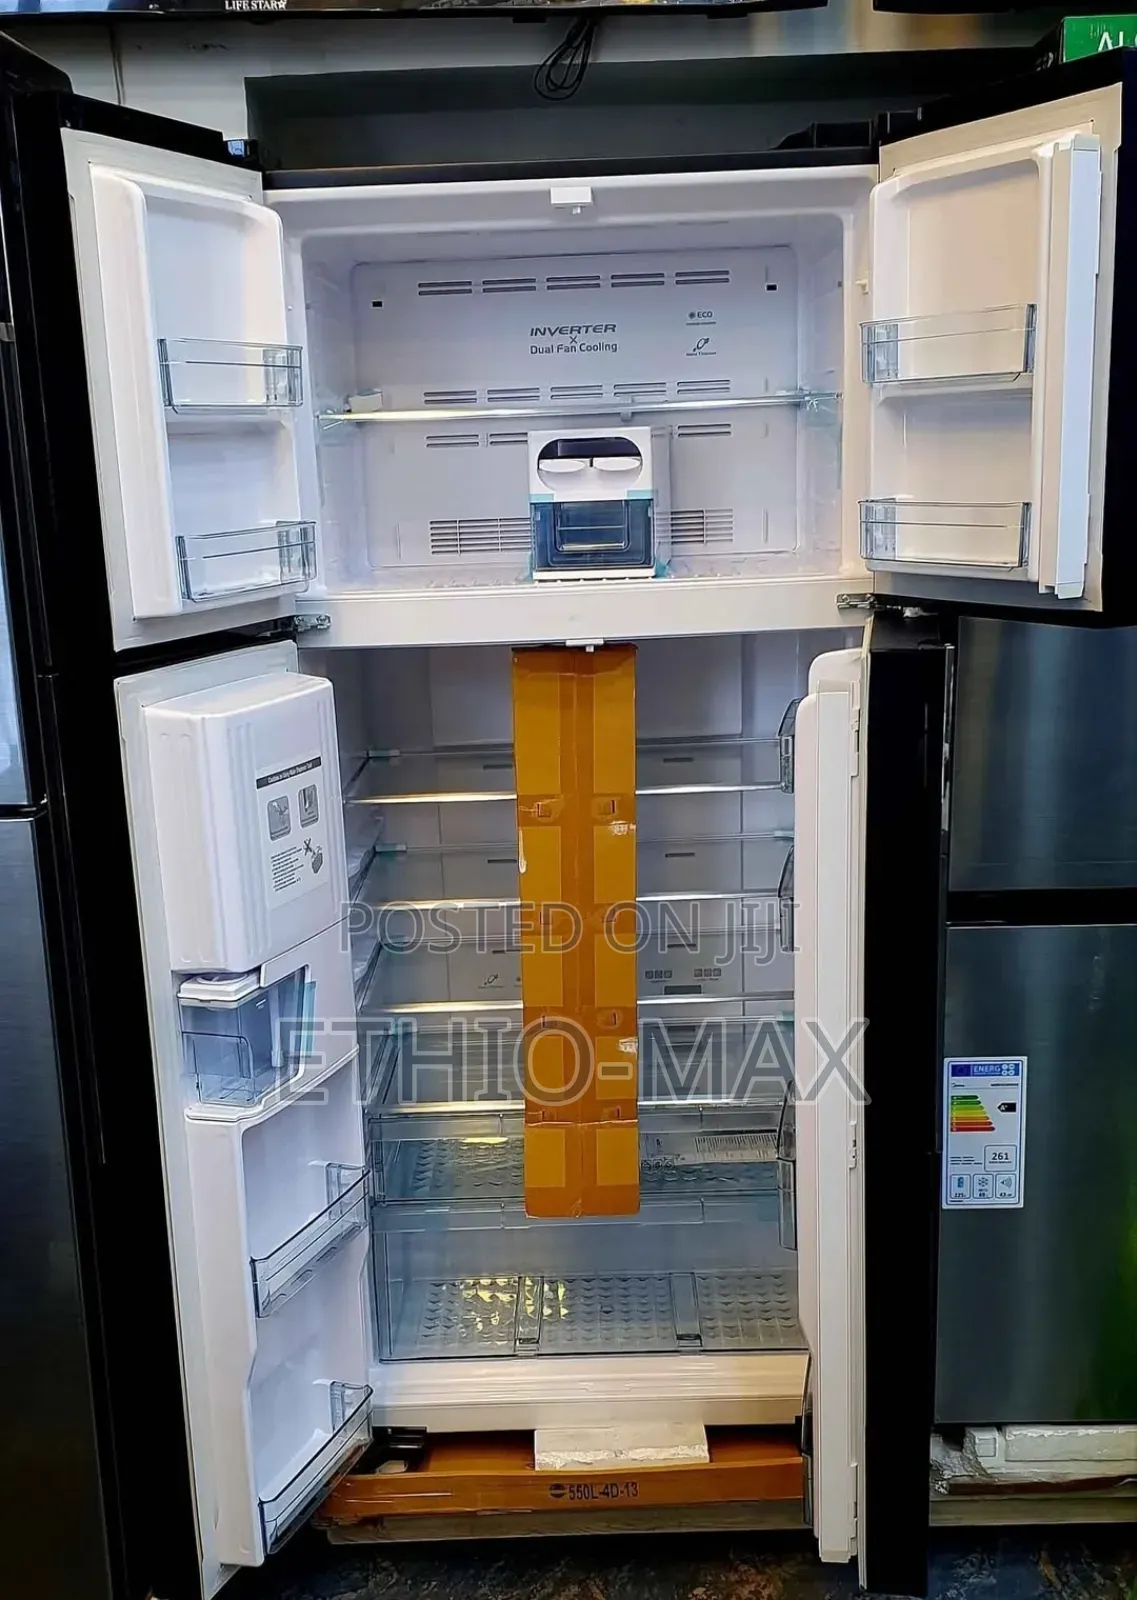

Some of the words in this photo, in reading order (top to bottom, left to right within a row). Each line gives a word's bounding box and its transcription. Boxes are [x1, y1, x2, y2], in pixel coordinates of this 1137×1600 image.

[225, 0, 249, 11] LIFE
[697, 311, 713, 319] ECO
[530, 324, 617, 337] INVERTER
[530, 345, 554, 355] Dual
[557, 343, 577, 354] Fan
[579, 341, 618, 353] Cooling
[973, 1065, 1001, 1073] ENERG
[991, 1152, 1010, 1161] 261
[567, 1481, 640, 1500] 550L-4D-13
